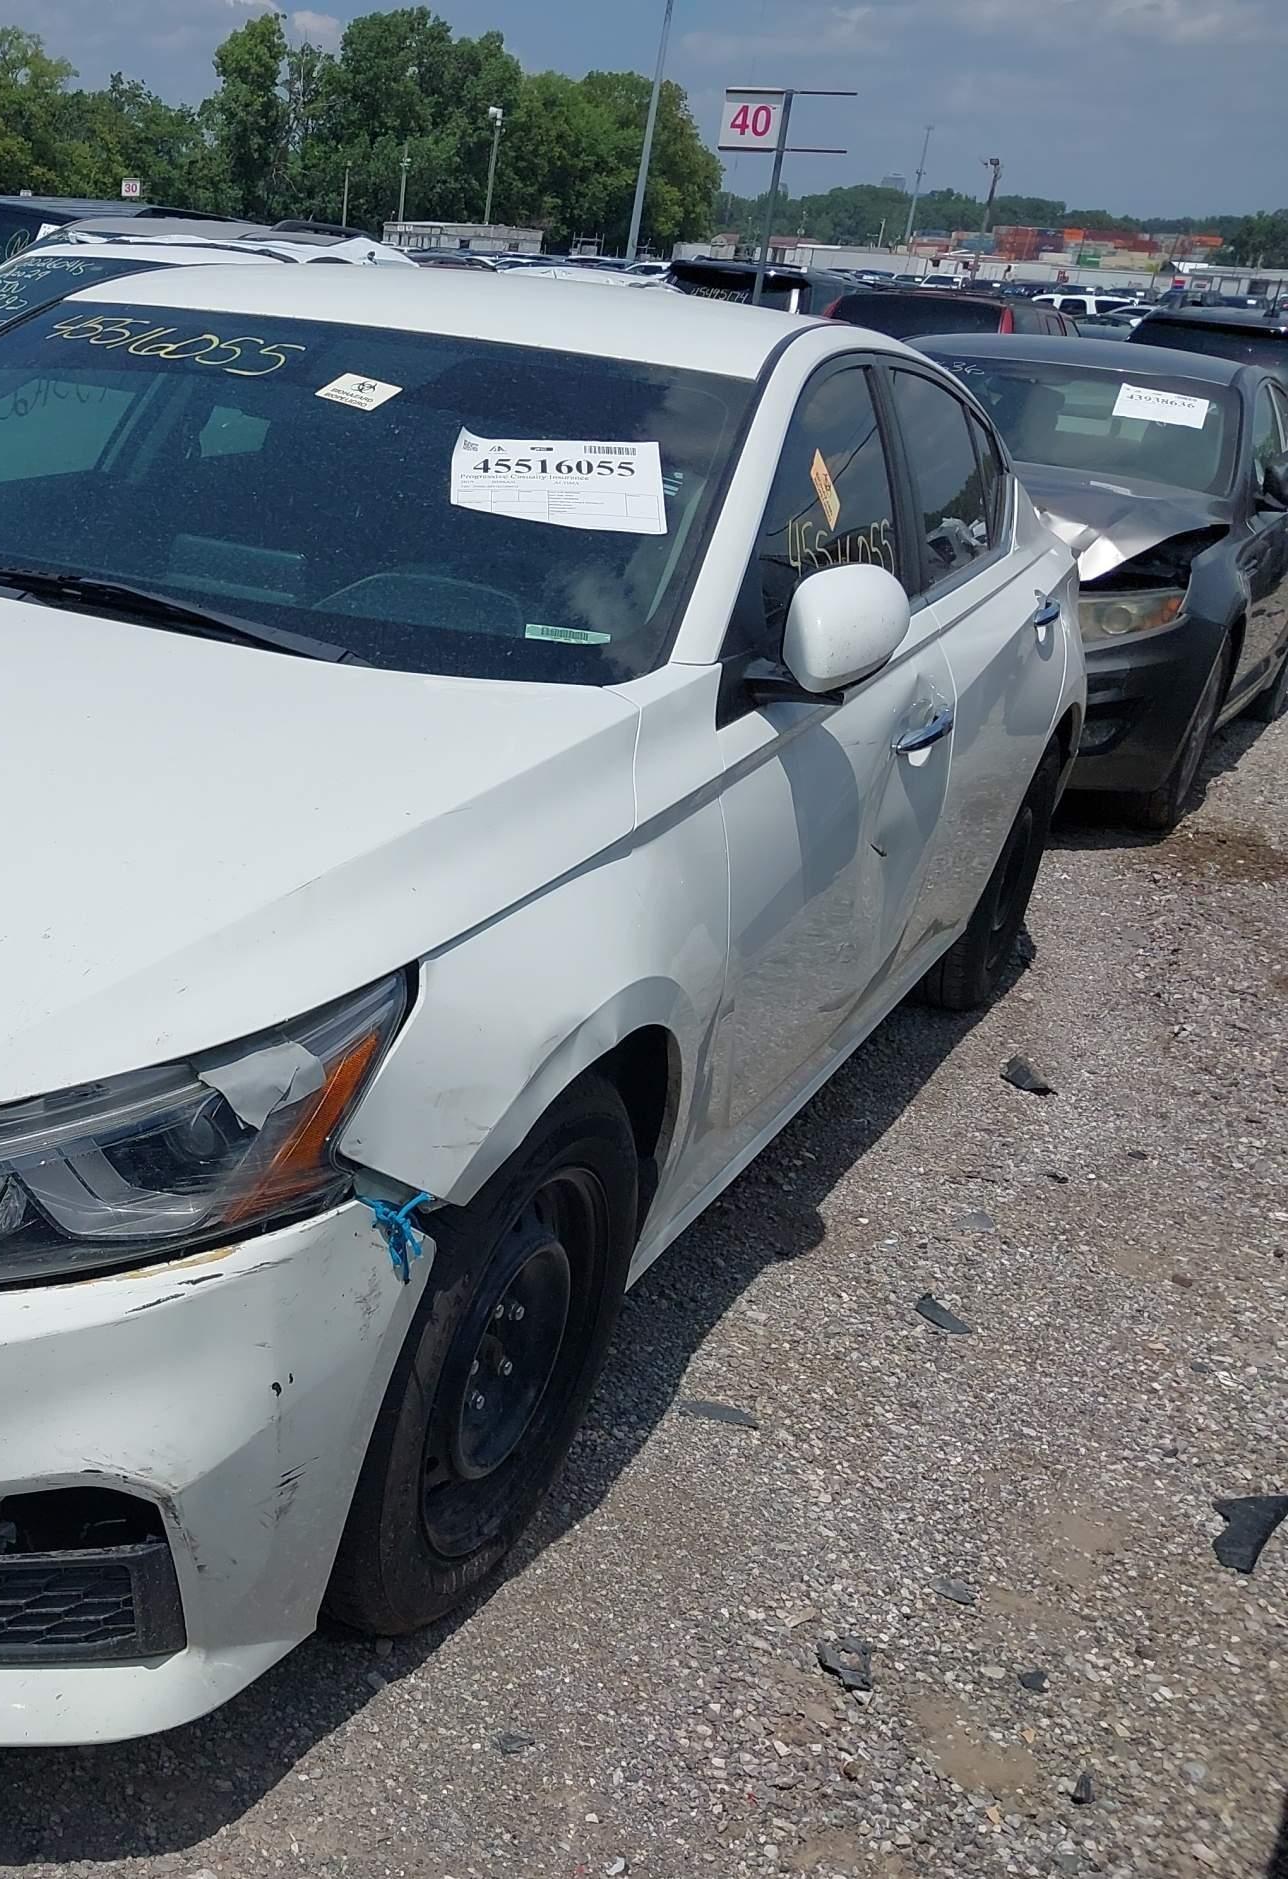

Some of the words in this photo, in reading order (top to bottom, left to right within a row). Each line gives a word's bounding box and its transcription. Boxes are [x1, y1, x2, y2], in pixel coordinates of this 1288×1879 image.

[730, 105, 771, 136] 40
[124, 183, 138, 193] 30
[45, 315, 306, 376] 45516055
[473, 459, 636, 477] 45516055
